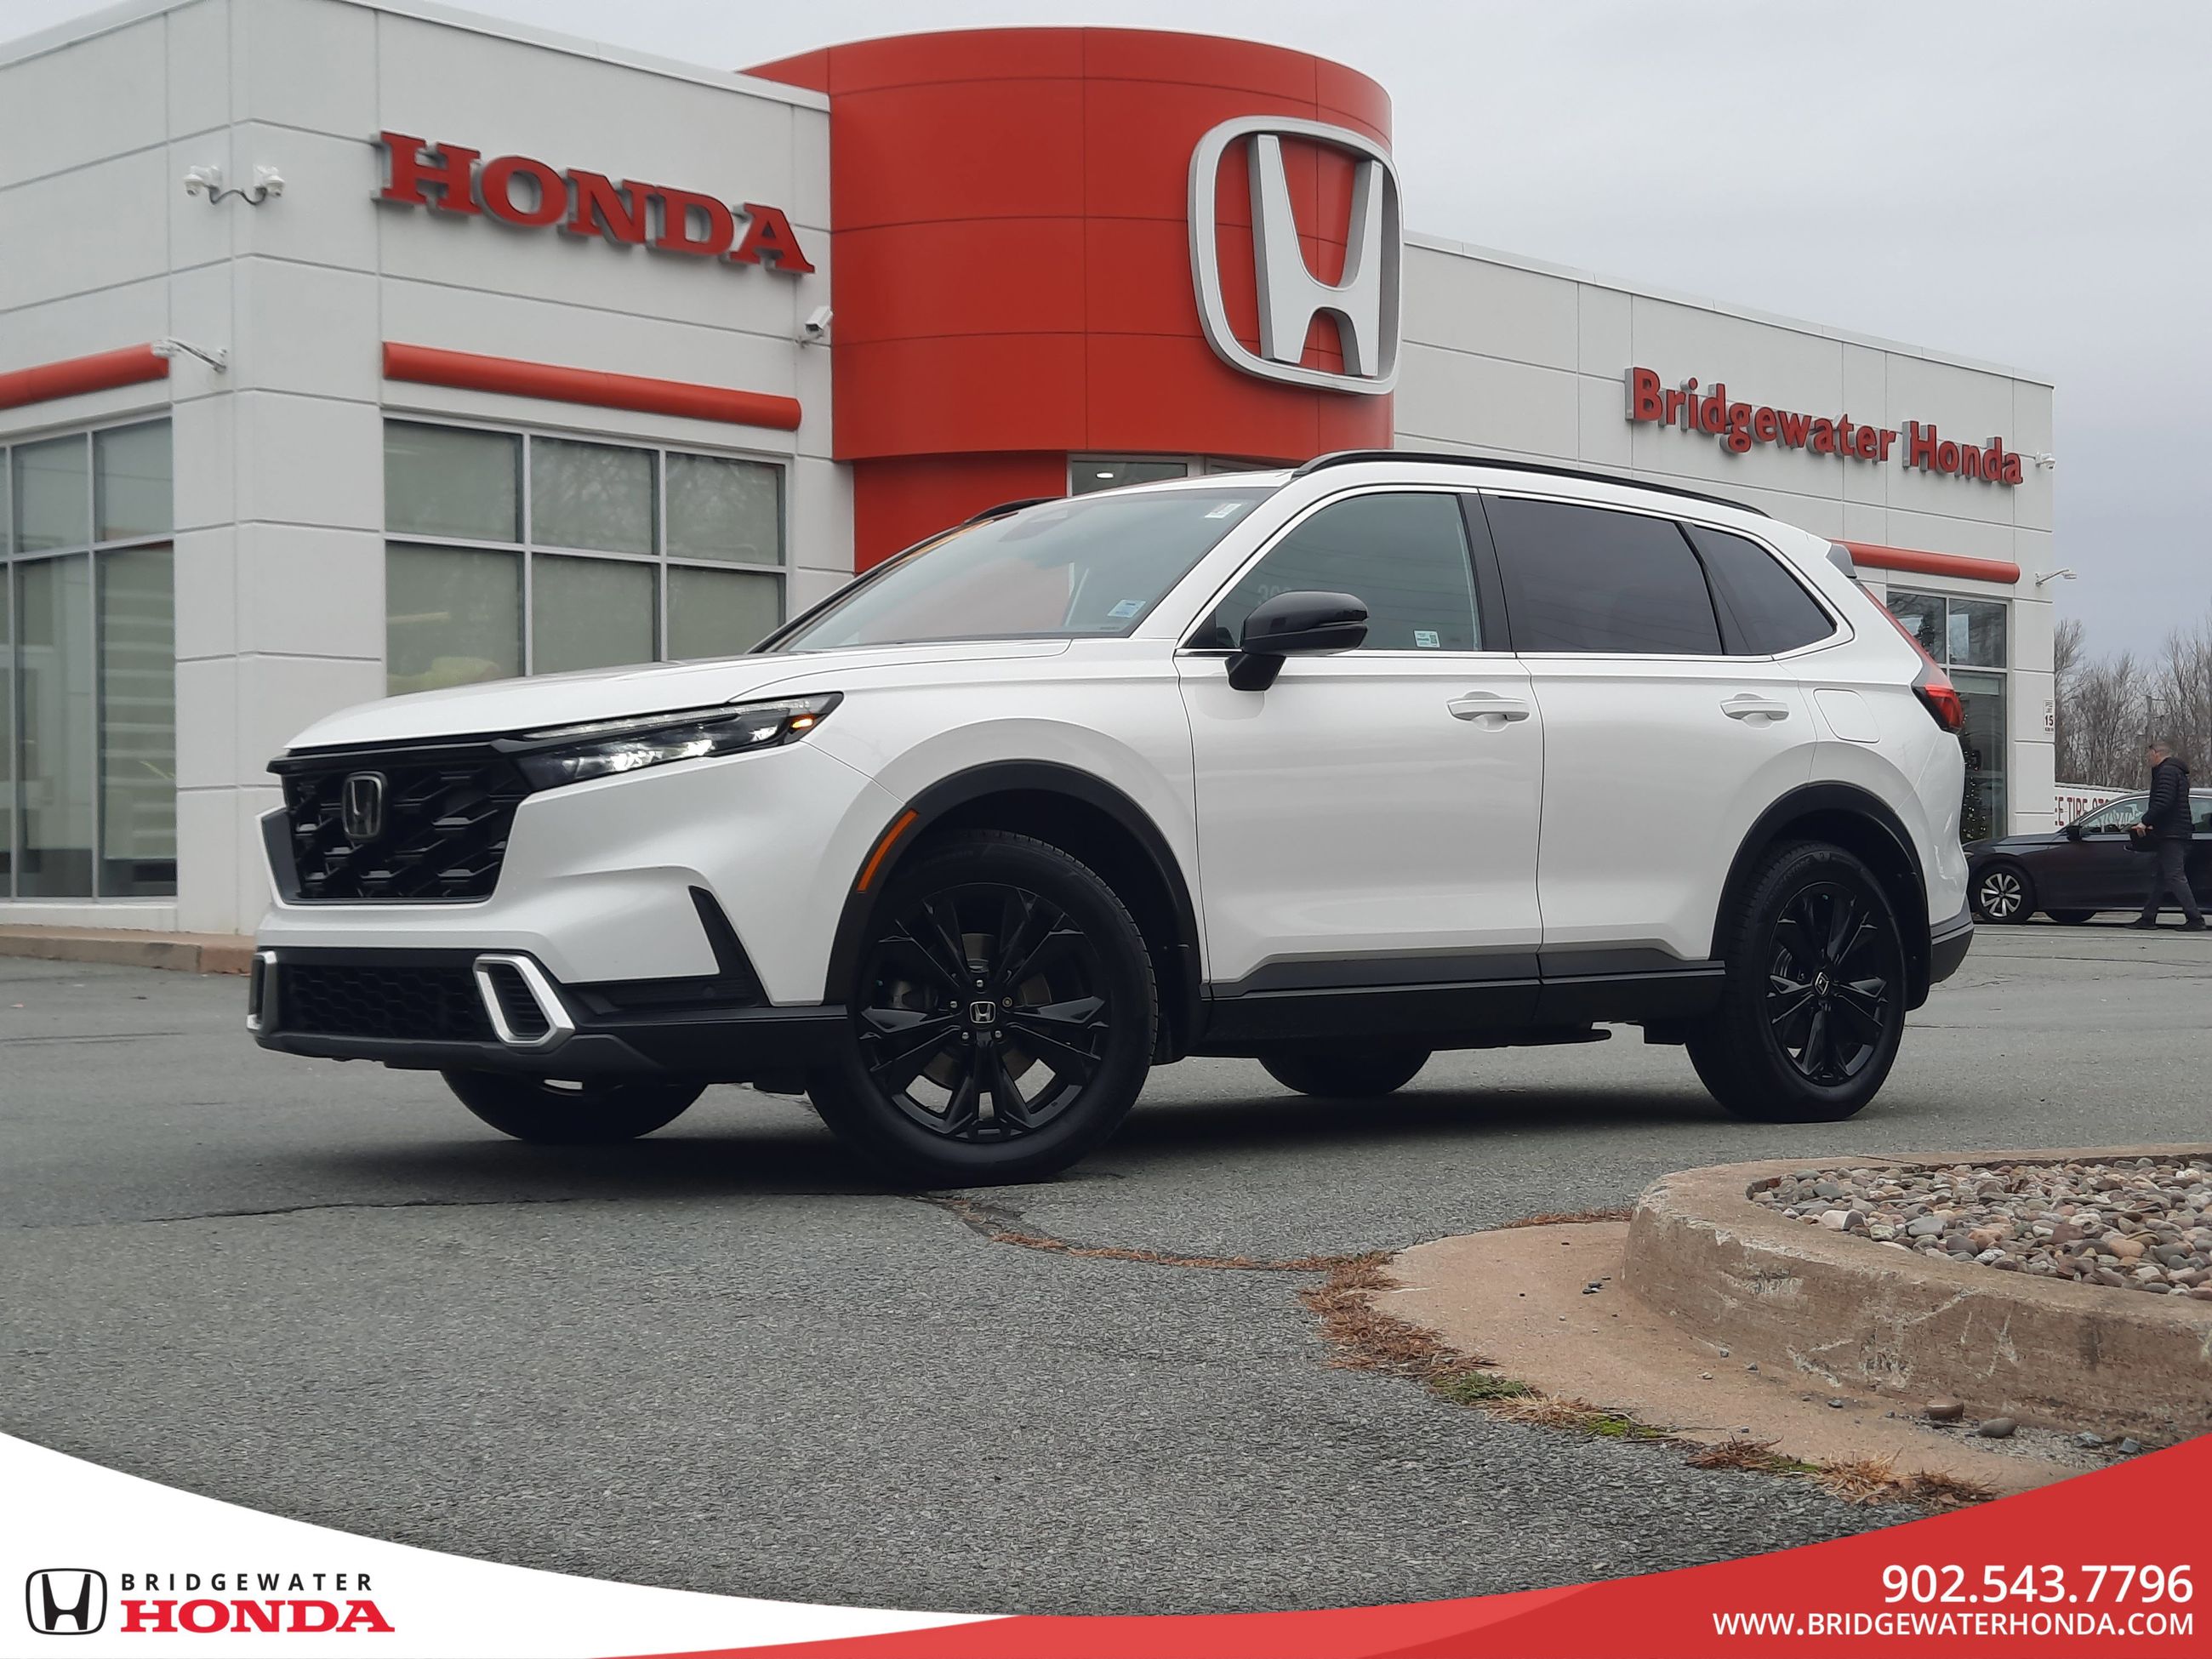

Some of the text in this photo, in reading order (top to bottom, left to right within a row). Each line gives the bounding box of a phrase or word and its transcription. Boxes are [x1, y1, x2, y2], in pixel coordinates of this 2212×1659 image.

[375, 130, 815, 273] HONDA
[1627, 367, 2023, 484] Bridgewater Honda
[2045, 715, 2054, 727] 15
